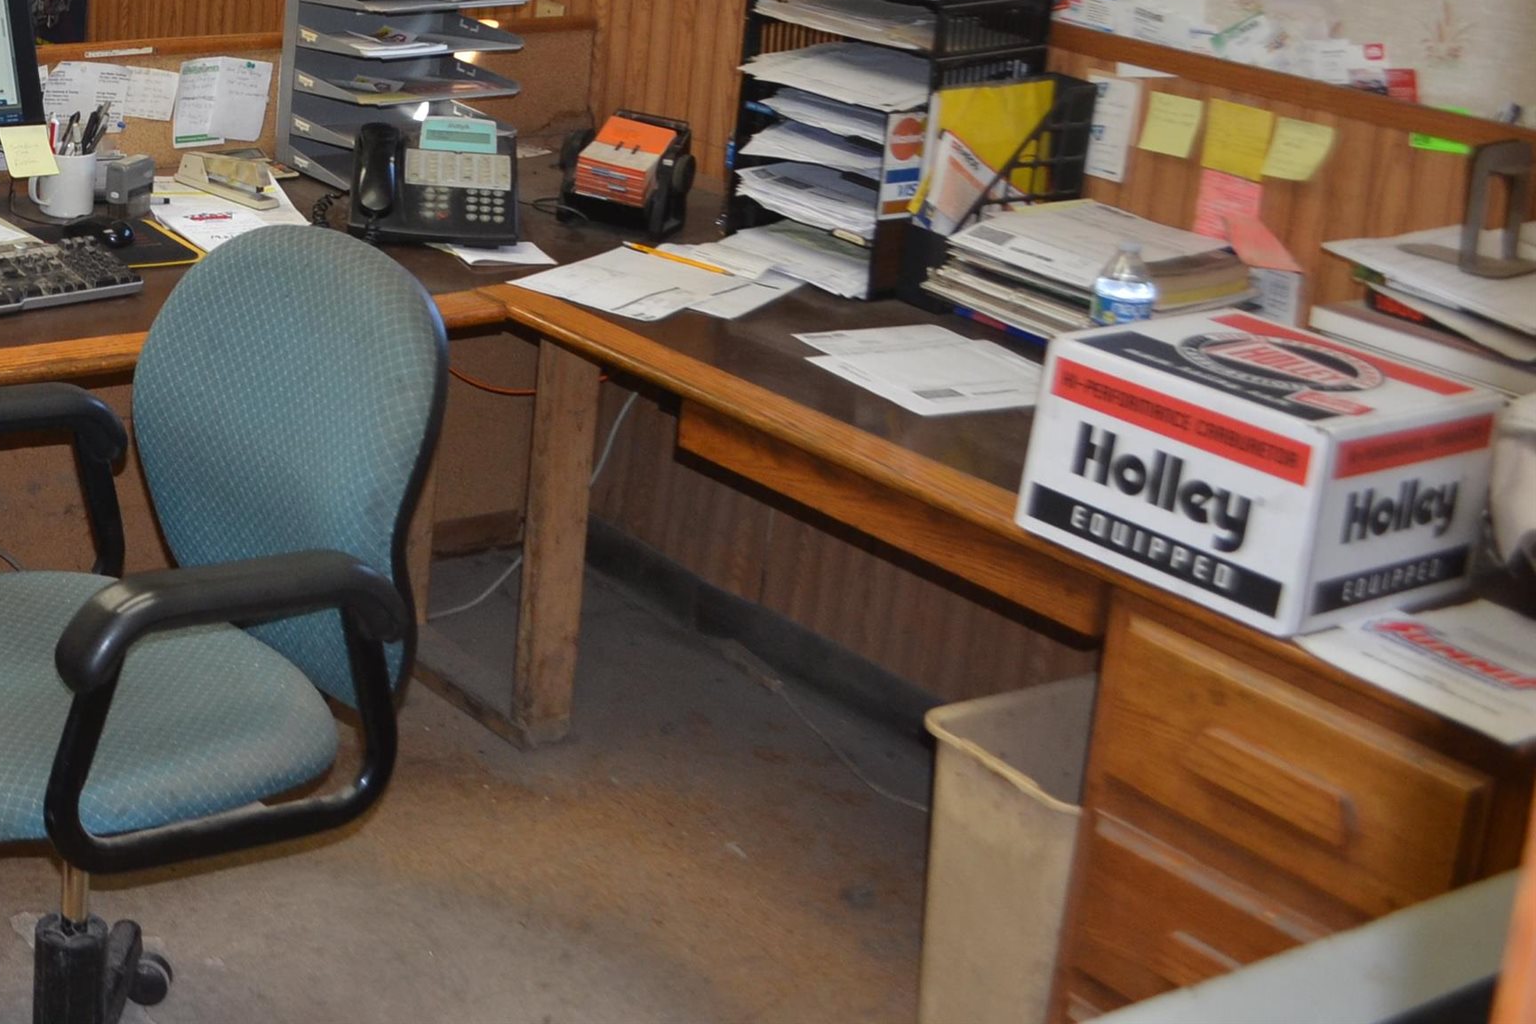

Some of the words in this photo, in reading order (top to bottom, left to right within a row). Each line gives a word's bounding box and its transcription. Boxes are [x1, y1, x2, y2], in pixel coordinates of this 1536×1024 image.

[1071, 421, 1251, 553] Holley
[1340, 478, 1459, 544] Holley
[1070, 505, 1234, 591] EQUIPPED
[1341, 558, 1440, 602] EQUIPPED
